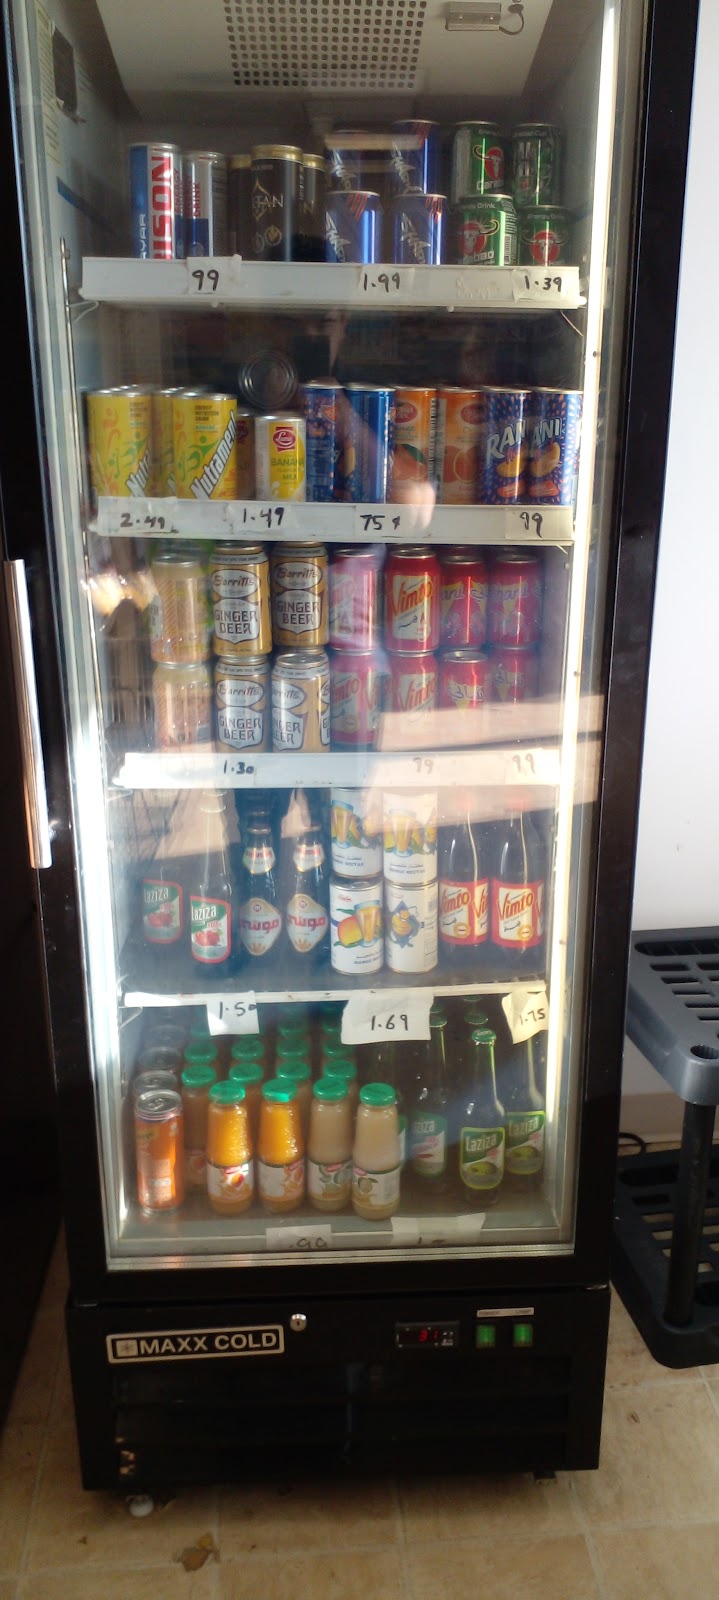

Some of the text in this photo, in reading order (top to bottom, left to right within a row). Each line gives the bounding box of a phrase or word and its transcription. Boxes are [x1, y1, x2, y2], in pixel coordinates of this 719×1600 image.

[192, 269, 219, 291] 99
[363, 272, 401, 293] 1.99
[524, 275, 562, 293] 1.39
[119, 512, 166, 529] 2.49
[243, 507, 285, 528] 1.49
[519, 511, 543, 538] 99
[277, 601, 319, 613] GINGER
[389, 580, 432, 616] Vimto
[214, 609, 258, 622] GINGER
[282, 613, 314, 625] BEER
[219, 623, 252, 634] BEER
[219, 716, 262, 729] GINGER
[223, 729, 255, 740] BEER
[223, 760, 255, 775] 1.30
[512, 753, 536, 774] 99
[497, 893, 533, 920] Vimto
[218, 1001, 257, 1019] 1.50
[519, 1008, 546, 1026] 1.75
[371, 1014, 409, 1031] 1.69
[509, 1117, 539, 1136] Laziza
[465, 1134, 497, 1152] Laziza
[139, 1332, 277, 1355] MAXX COLD
